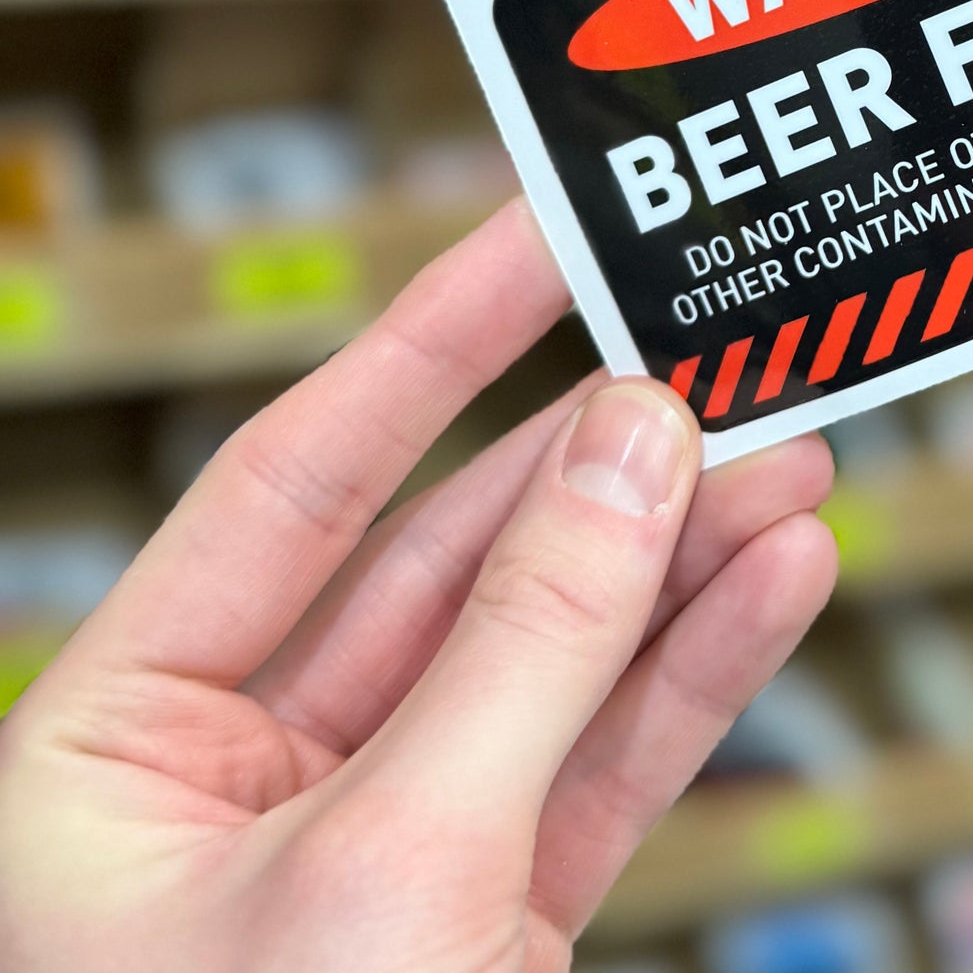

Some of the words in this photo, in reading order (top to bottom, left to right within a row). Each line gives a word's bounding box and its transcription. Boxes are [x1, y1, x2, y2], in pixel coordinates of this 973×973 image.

[605, 47, 918, 234] BEER
[683, 234, 736, 279] DO
[740, 200, 812, 256] NOT
[820, 149, 945, 224] PLACE
[671, 258, 790, 325] OTHER
